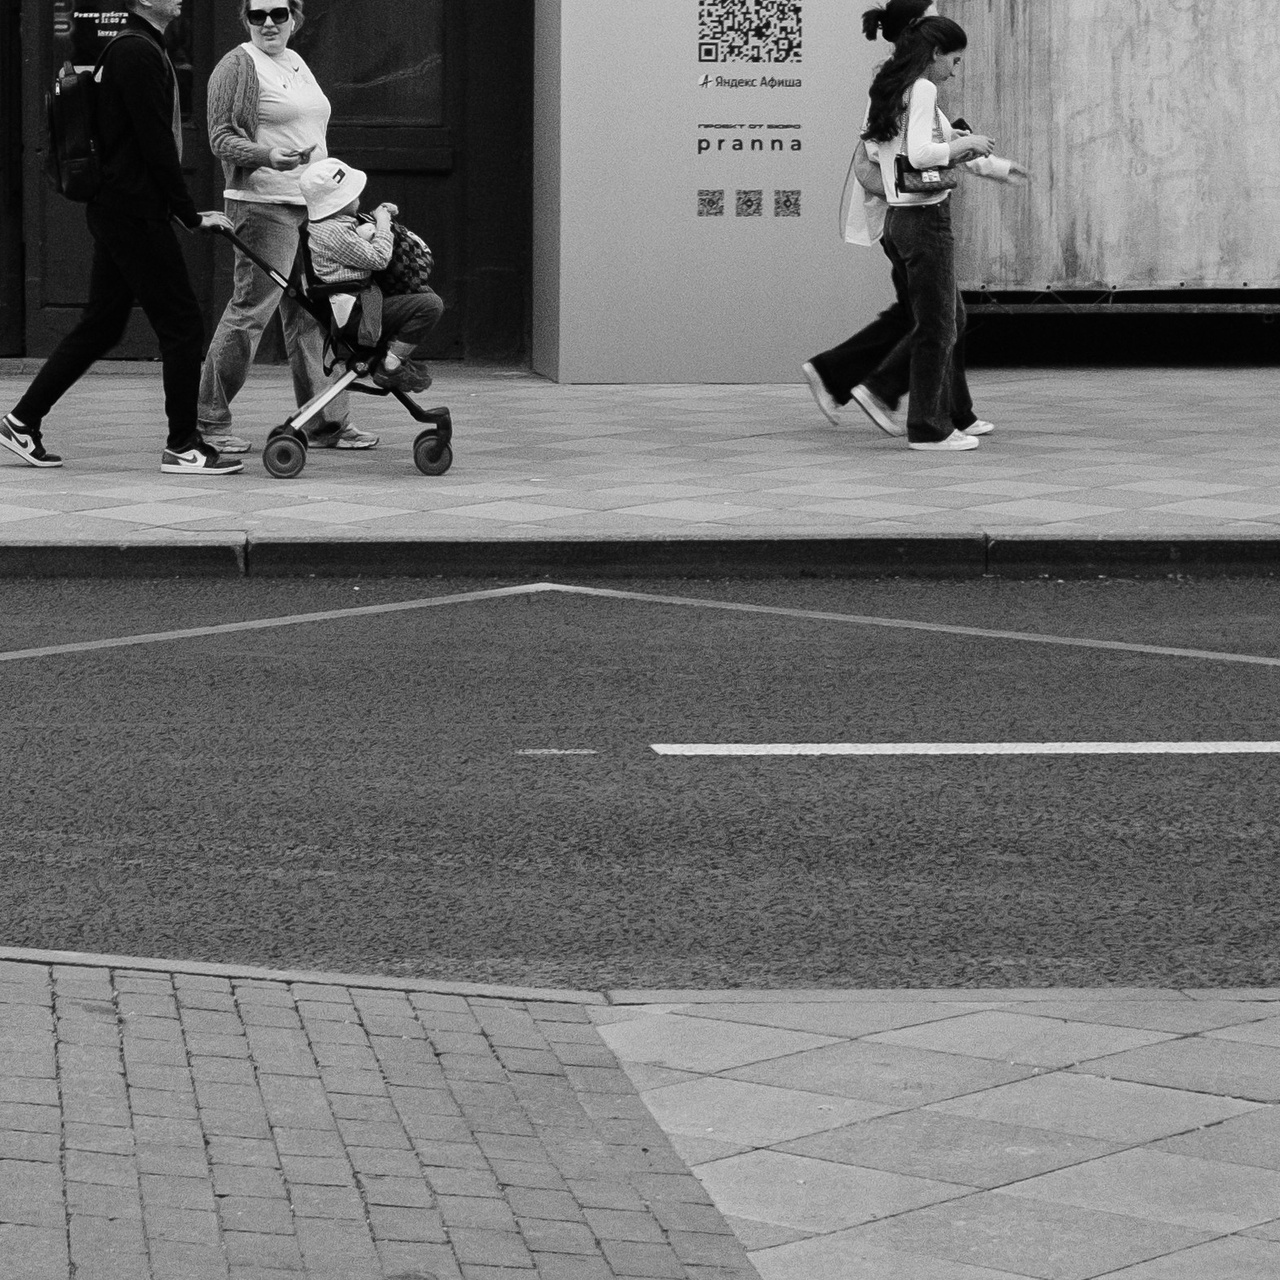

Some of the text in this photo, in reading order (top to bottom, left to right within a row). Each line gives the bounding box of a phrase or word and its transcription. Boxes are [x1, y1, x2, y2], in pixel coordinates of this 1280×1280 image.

[715, 75, 757, 88] Яндекс
[759, 76, 802, 89] Афиша
[697, 138, 802, 155] pranna
